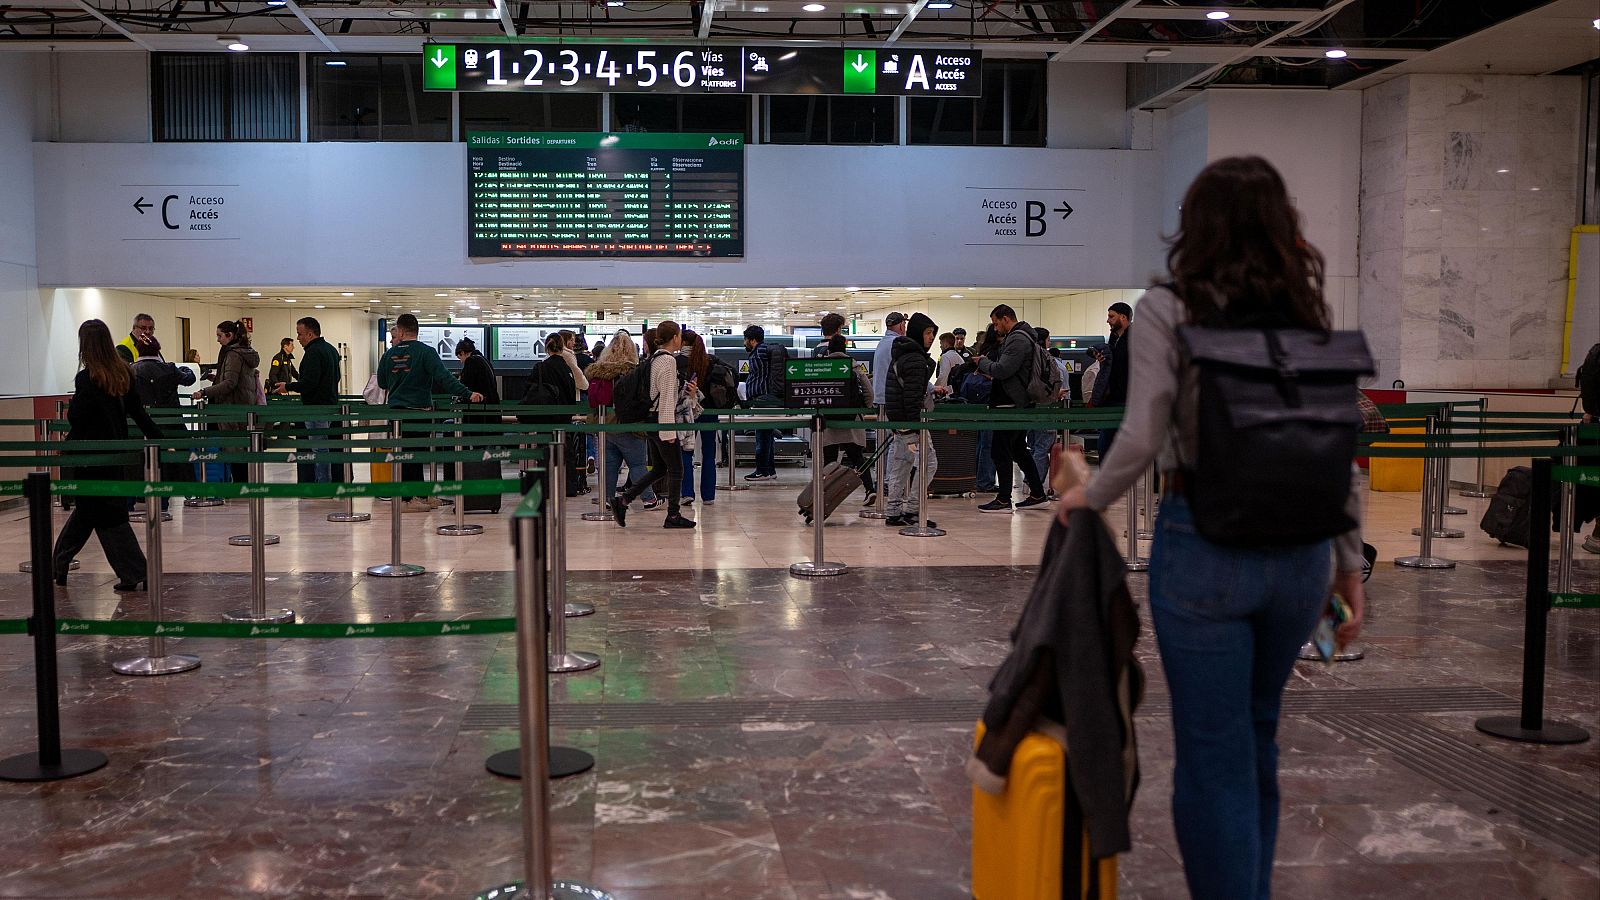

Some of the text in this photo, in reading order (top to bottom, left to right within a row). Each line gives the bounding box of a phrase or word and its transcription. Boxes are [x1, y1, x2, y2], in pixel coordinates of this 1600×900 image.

[701, 51, 723, 62] Vías
[935, 55, 971, 66] Acceso
[701, 66, 724, 77] Vies
[904, 54, 930, 90] A
[935, 68, 965, 80] Accés
[701, 80, 737, 88] PLATFORMS
[935, 83, 957, 91] ACCESS
[472, 136, 500, 144] Salidas
[506, 136, 540, 145] Sortides
[189, 195, 224, 205] Acceso
[981, 199, 1018, 209] Acceso
[162, 195, 180, 230] C
[189, 209, 219, 219] Accés
[987, 213, 1017, 224] Accés
[1025, 200, 1047, 237] B
[994, 228, 1017, 236] ACCESS
[296, 452, 316, 460] adif
